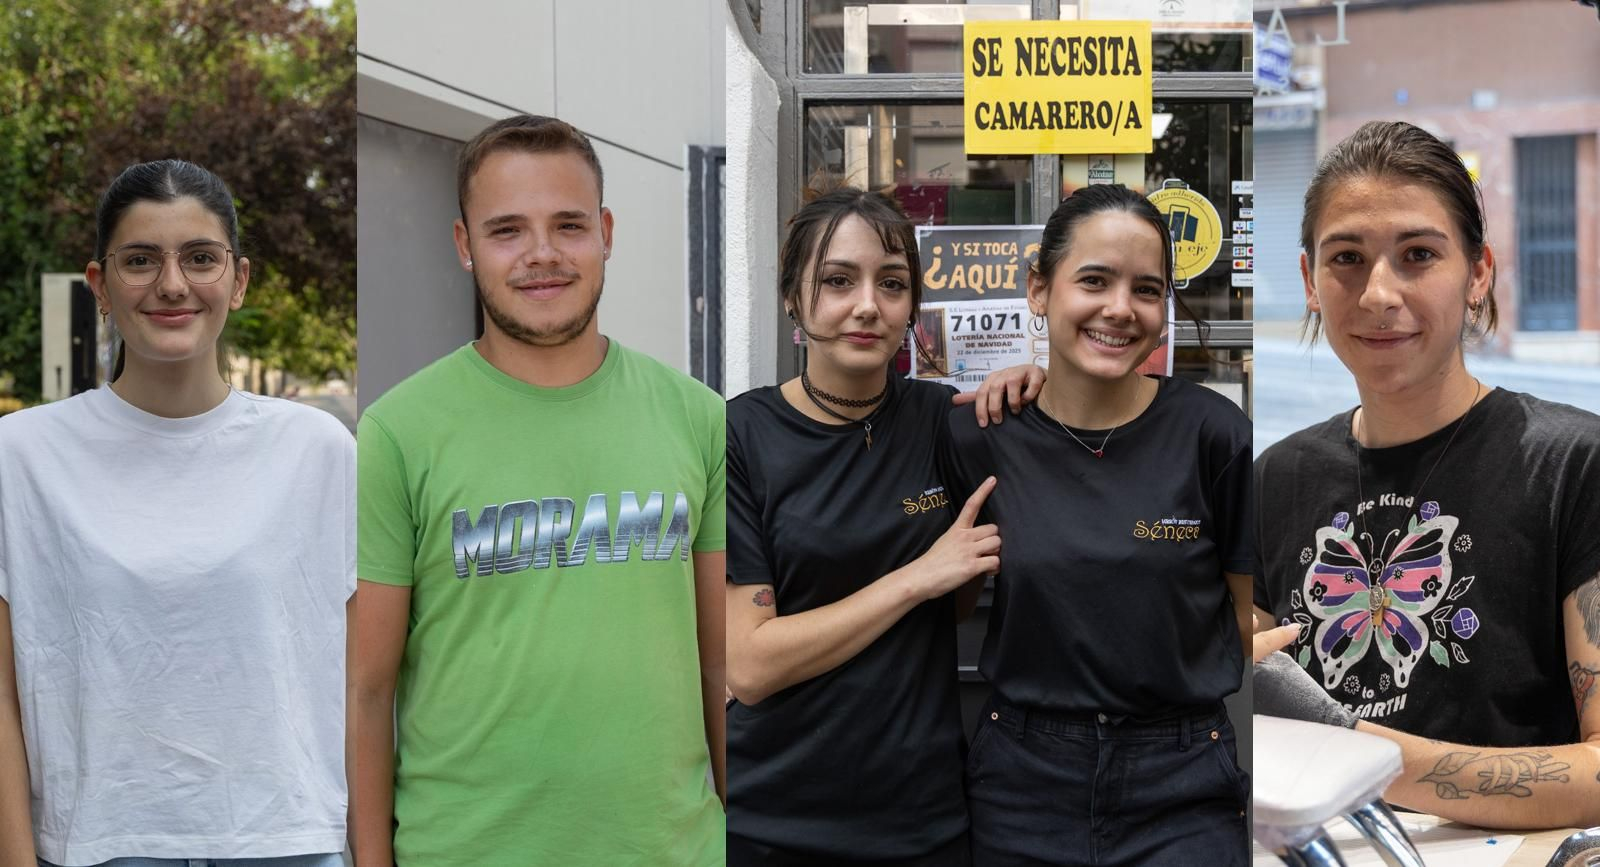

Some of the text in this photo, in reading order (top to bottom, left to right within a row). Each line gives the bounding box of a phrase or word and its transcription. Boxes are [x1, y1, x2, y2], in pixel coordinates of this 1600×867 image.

[972, 36, 1142, 77] SE NECESITA
[974, 100, 1142, 136] CAMARERO/A
[951, 241, 1018, 256] Y SI TOCA
[950, 312, 1021, 332] 71071
[951, 332, 984, 341] LOTERÍA
[1379, 493, 1415, 508] Kind
[452, 491, 690, 578] MORAMA
[1361, 686, 1375, 699] to
